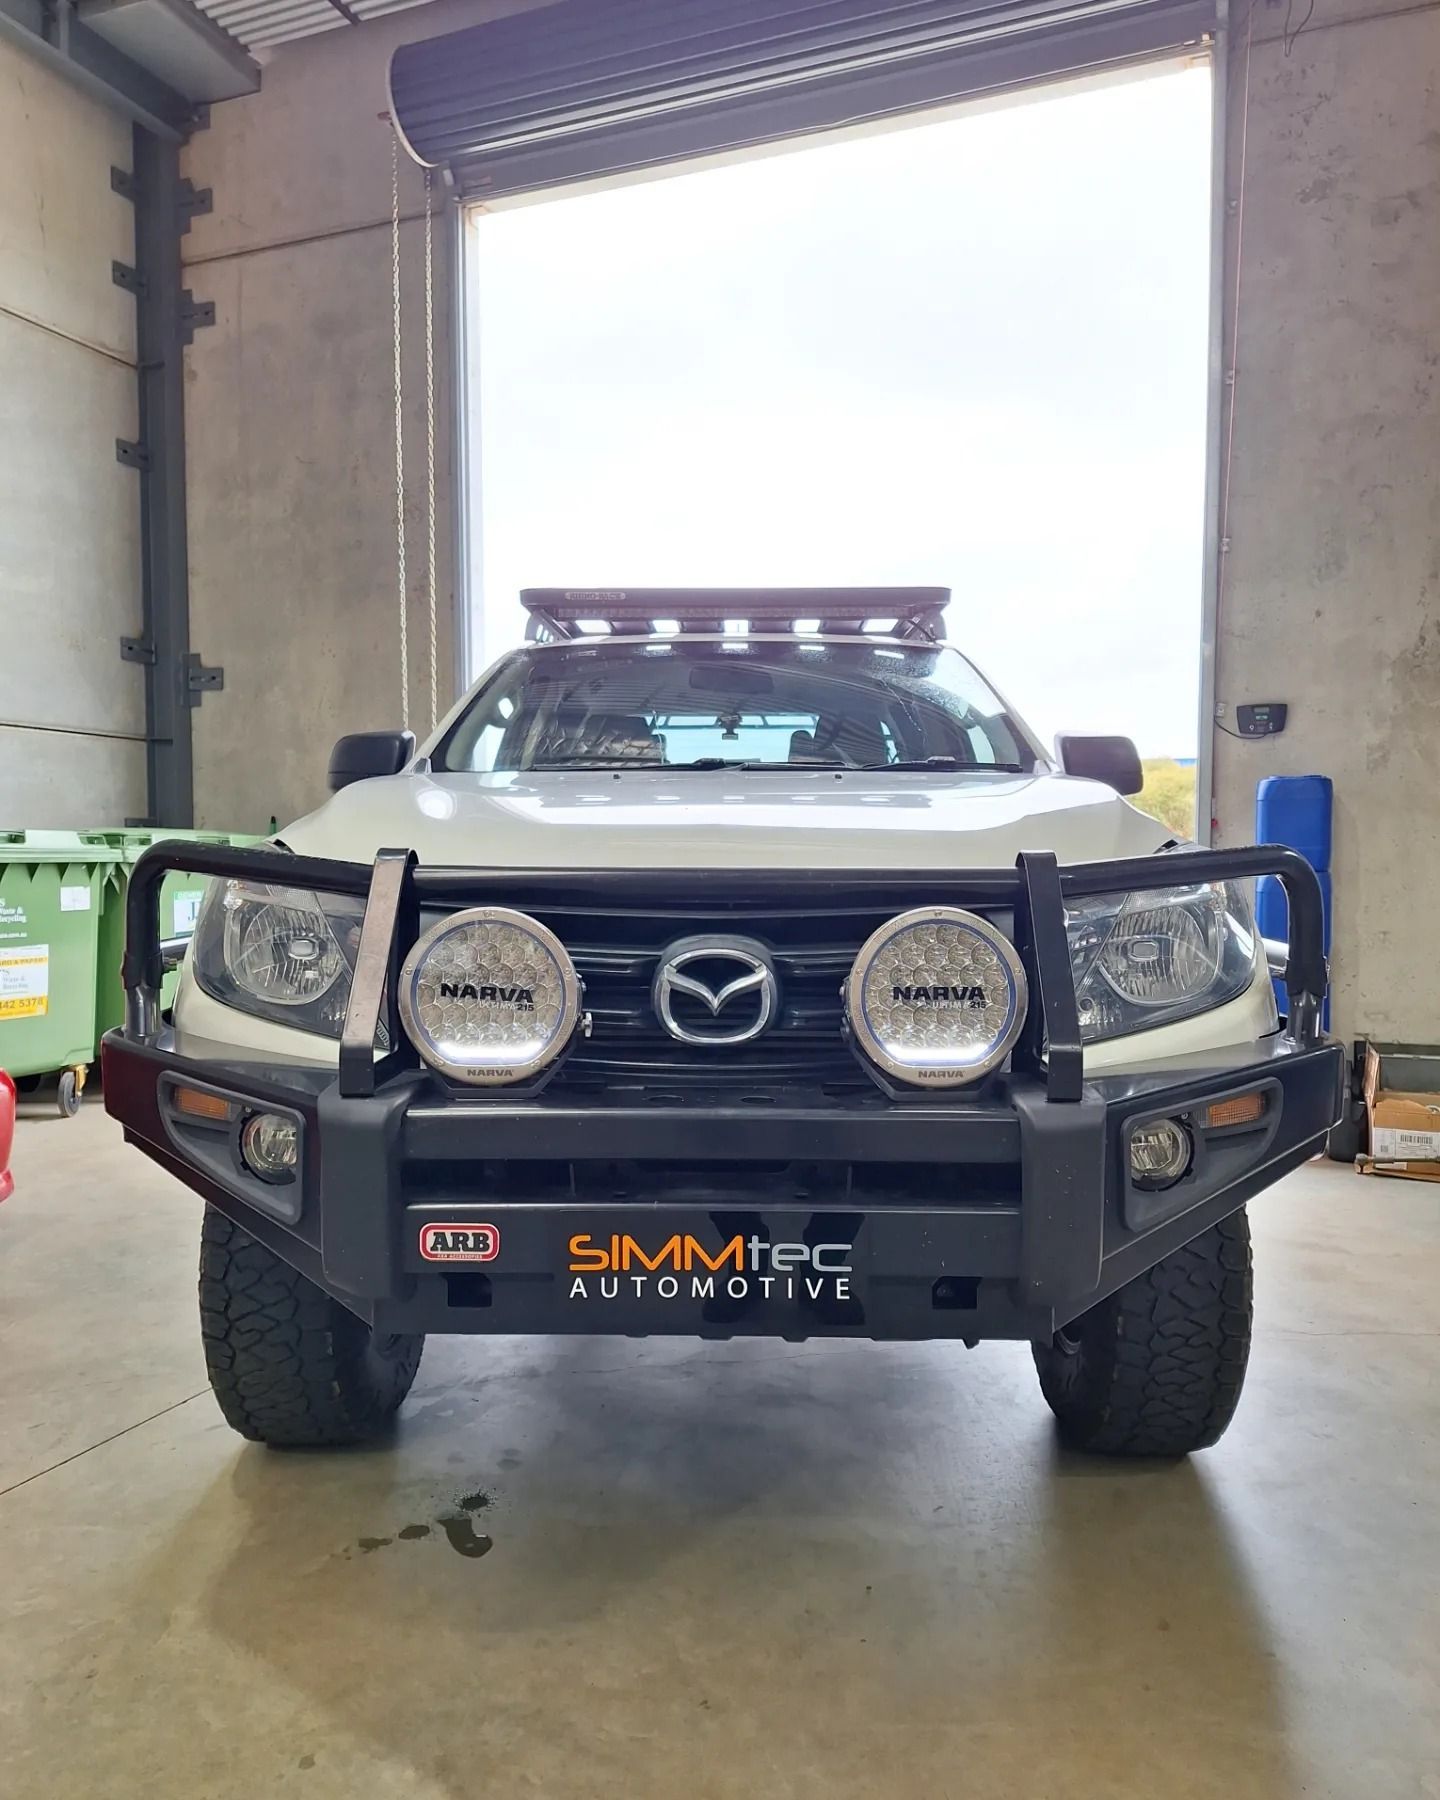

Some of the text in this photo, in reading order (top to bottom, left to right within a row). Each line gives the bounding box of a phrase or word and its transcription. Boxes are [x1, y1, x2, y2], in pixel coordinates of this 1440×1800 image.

[441, 983, 534, 1003] NARVA
[893, 986, 985, 1001] NARVA
[467, 1068, 513, 1077] NARVA
[918, 1070, 964, 1079] NARVA
[430, 1232, 490, 1252] ARB
[569, 1234, 852, 1272] SIMMtec
[569, 1276, 850, 1299] AUTOMOTIVE
